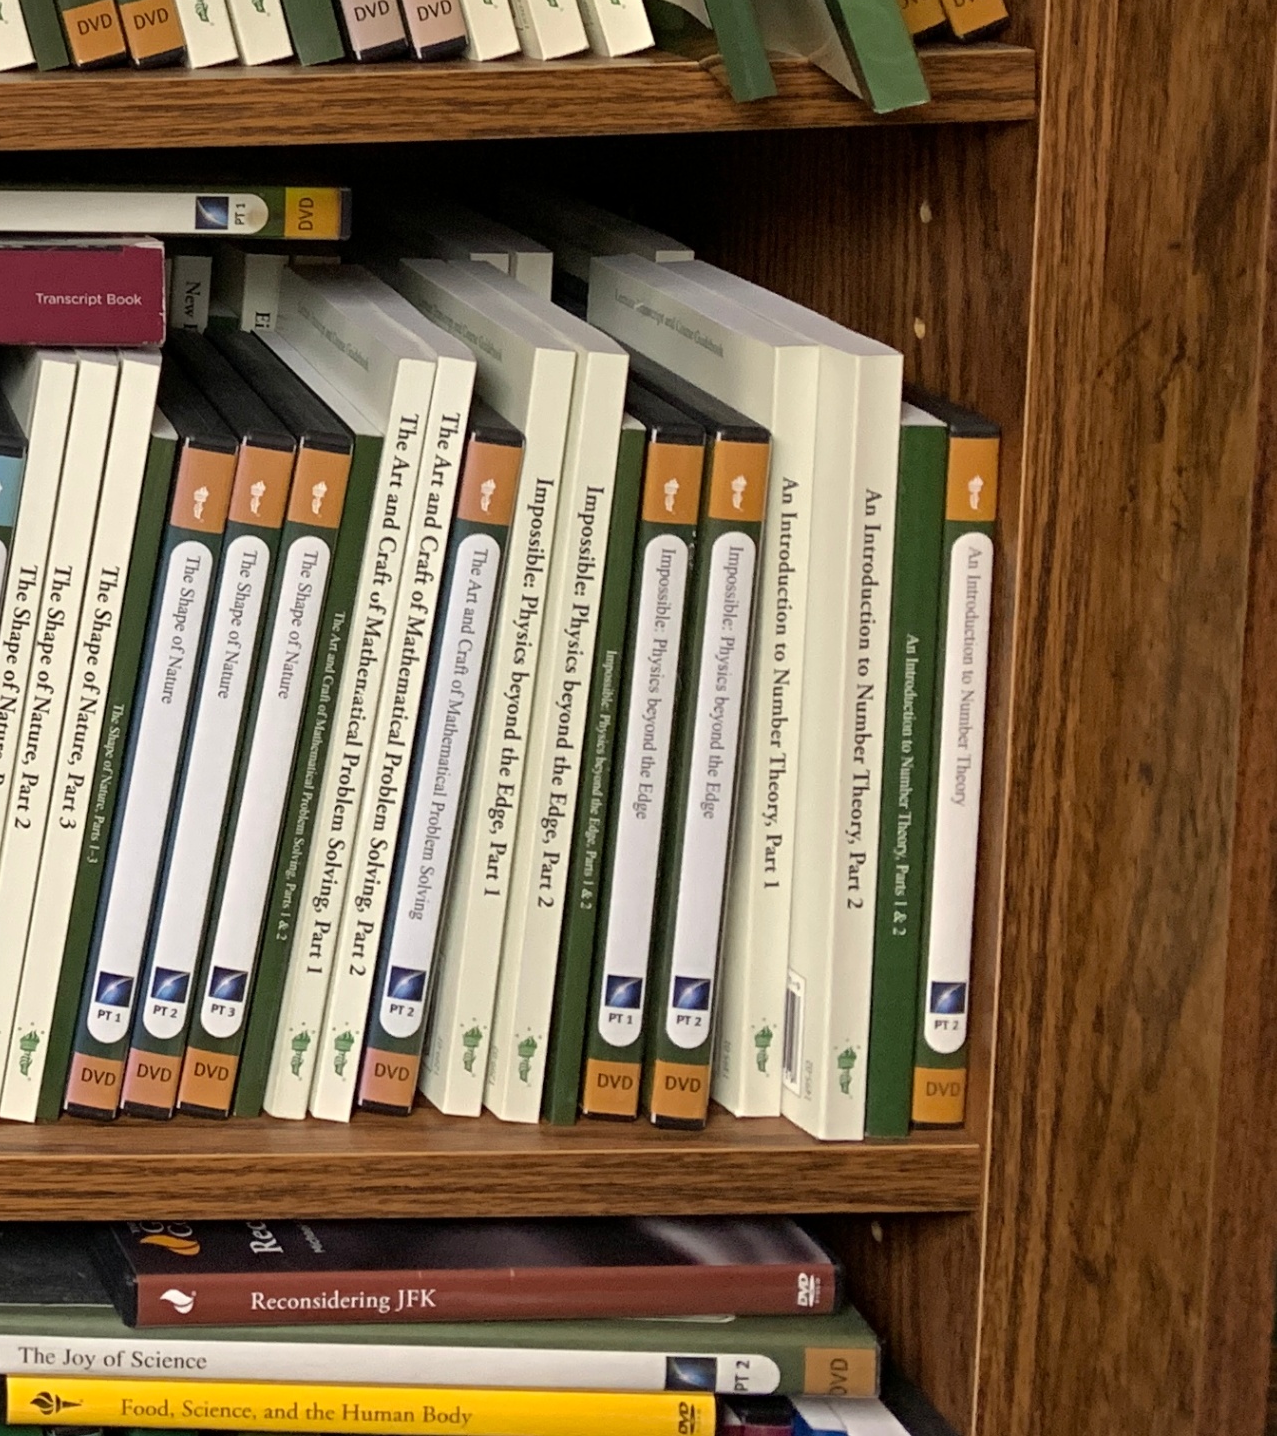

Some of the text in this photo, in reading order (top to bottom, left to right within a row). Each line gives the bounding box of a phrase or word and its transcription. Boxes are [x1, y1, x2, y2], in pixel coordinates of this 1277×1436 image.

[234, 212, 246, 226] PT
[297, 196, 315, 232] DVD
[34, 291, 143, 308] Transcript Book
[348, 411, 462, 978] The Art and Craft of Mathematical Problem Solving, Part 2
[536, 485, 606, 909] Impossible: Physics beyond the Edge, Part 2
[843, 487, 884, 911] An Introduction to Number Theory, Part 2
[250, 1287, 437, 1315] Reconsidering JFK
[797, 1272, 809, 1307] DVD
[16, 1345, 209, 1375] The Joy of Science
[734, 1373, 750, 1393] PT
[118, 1397, 474, 1430] Food, Science, and the Human Body
[677, 1401, 690, 1435] DVD
